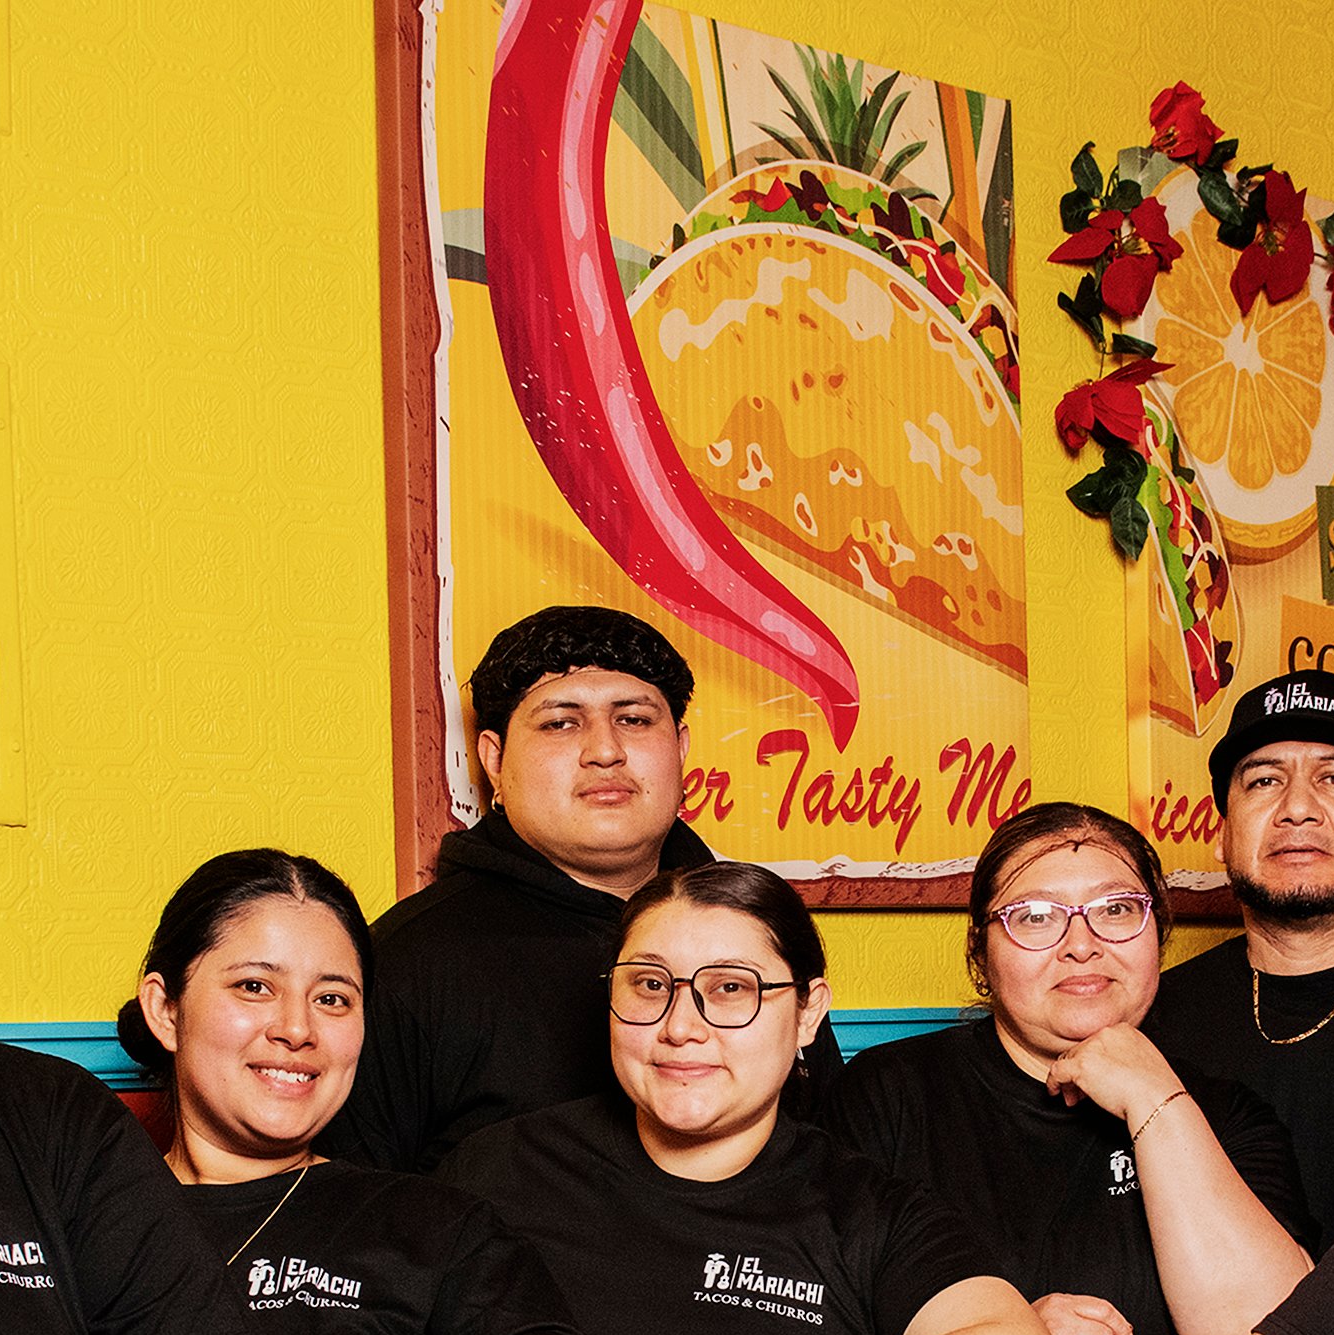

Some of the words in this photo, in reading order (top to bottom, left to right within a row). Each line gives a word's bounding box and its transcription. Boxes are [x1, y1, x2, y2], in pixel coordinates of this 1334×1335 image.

[1291, 682, 1311, 696] EL
[756, 729, 922, 856] Tasty
[1151, 779, 1224, 845] ica
[286, 1257, 308, 1275] EL
[741, 1257, 764, 1274] EL
[736, 1273, 825, 1305] MARIACHI
[693, 1291, 740, 1306] TACOS
[741, 1297, 753, 1308] &
[755, 1299, 824, 1326] CHURROS
